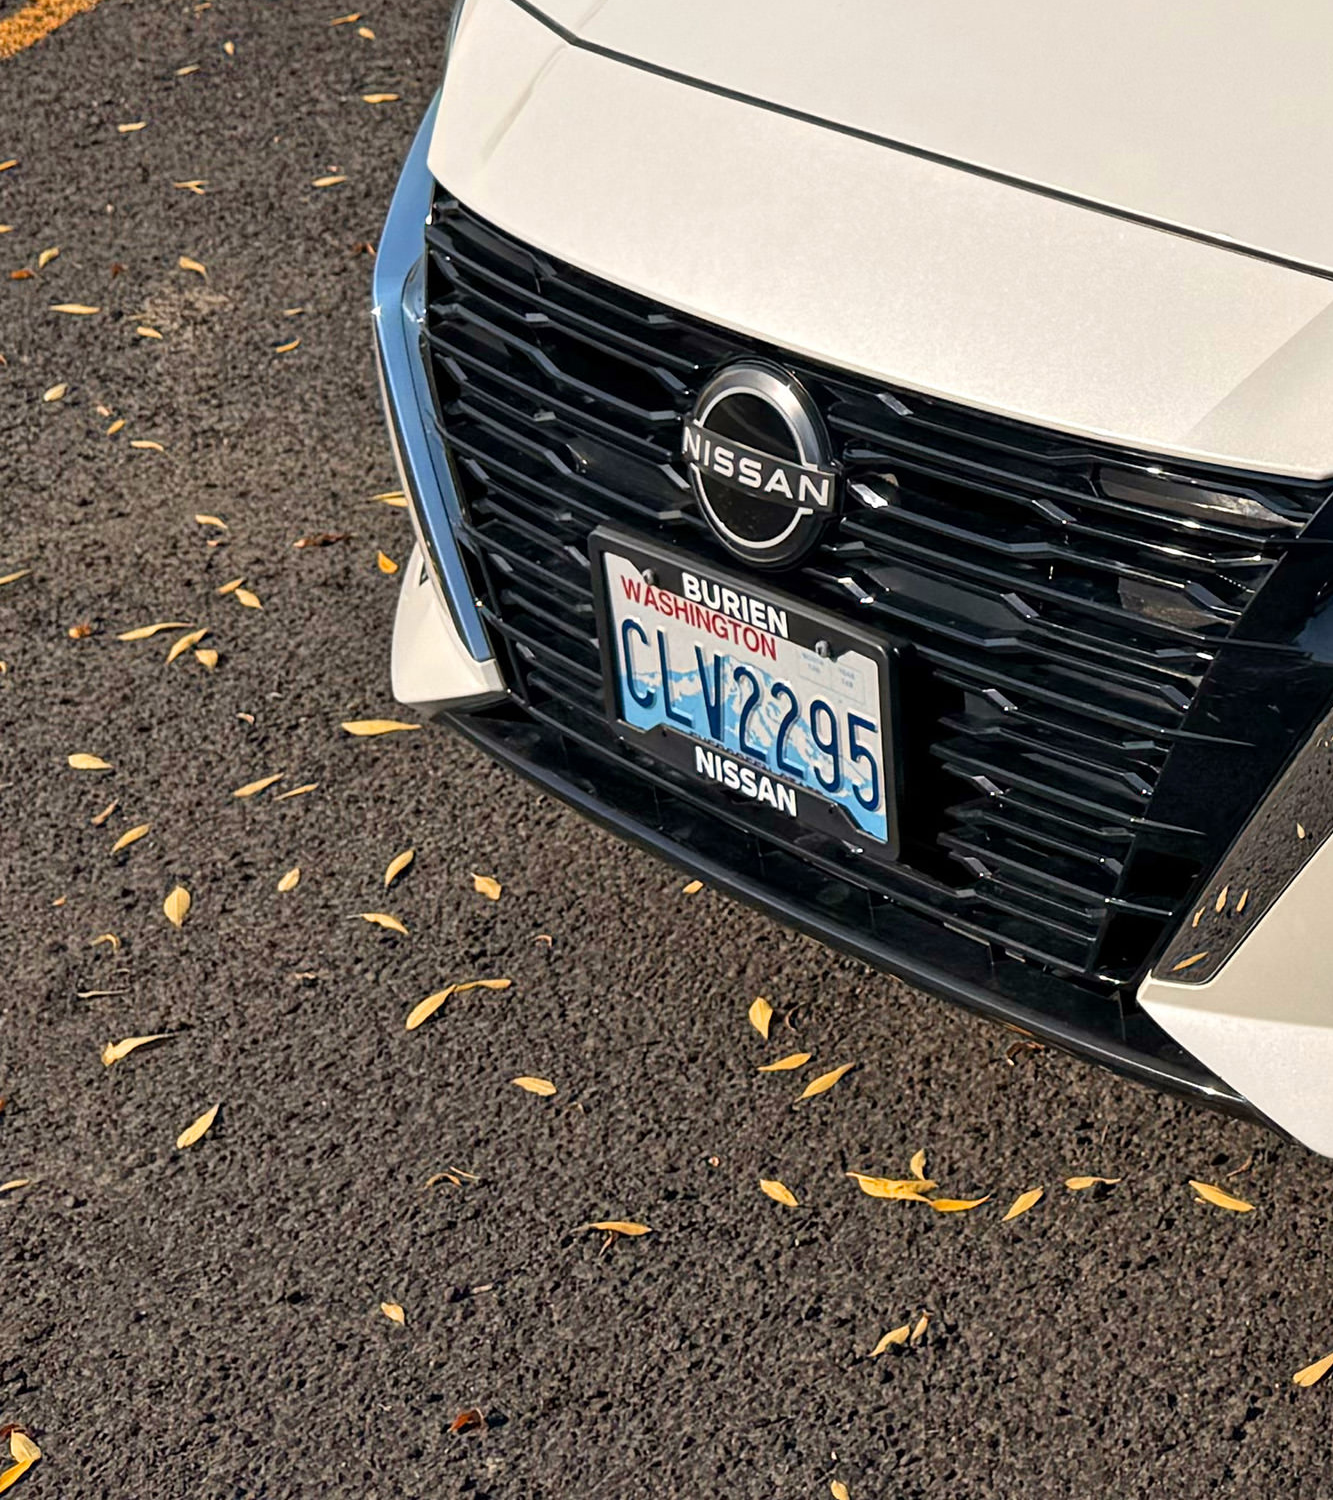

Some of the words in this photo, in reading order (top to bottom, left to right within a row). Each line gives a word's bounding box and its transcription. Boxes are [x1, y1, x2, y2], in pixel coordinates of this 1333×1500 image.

[682, 426, 830, 506] NISSAN
[621, 575, 777, 661] WASHINGTON
[682, 572, 789, 638] BURIEN
[621, 618, 880, 812] CLV2295
[695, 746, 797, 817] NISSAN
